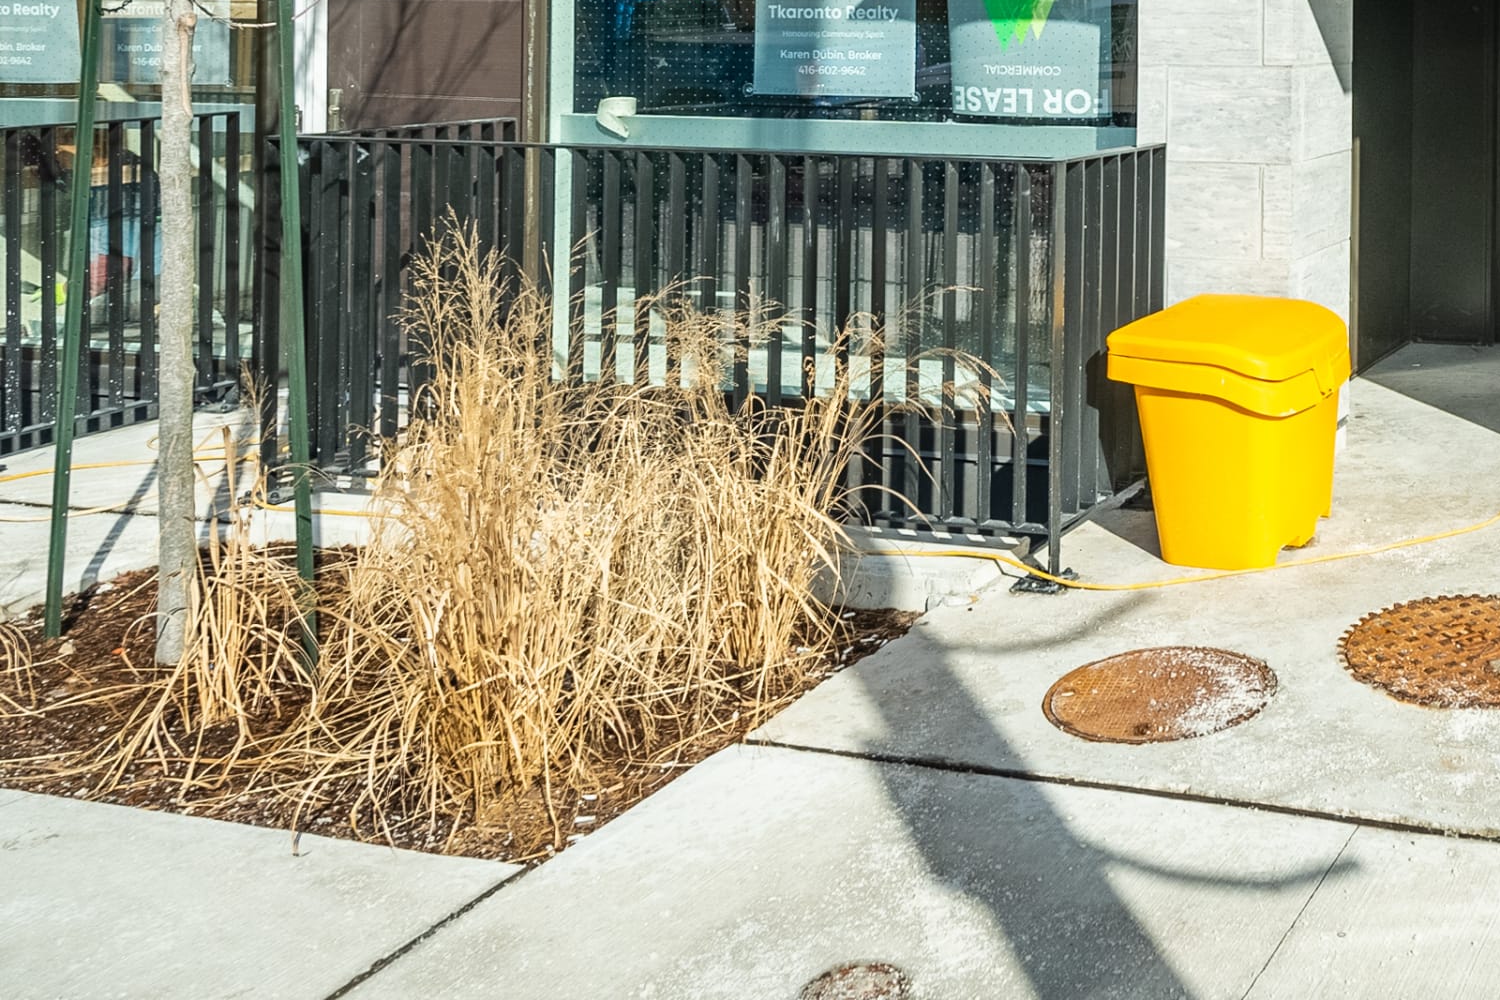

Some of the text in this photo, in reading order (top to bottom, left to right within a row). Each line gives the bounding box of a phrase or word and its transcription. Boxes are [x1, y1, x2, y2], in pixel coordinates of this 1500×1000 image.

[13, 3, 60, 18] Realty
[768, 3, 899, 23] Tkaronto Realty
[16, 42, 46, 52] Broker
[780, 50, 882, 61] Karen Dubin, Broker
[798, 65, 866, 76] 416-602-9642
[983, 63, 1061, 76] COMMERCIAL
[955, 86, 1109, 115] FOR LEASE
